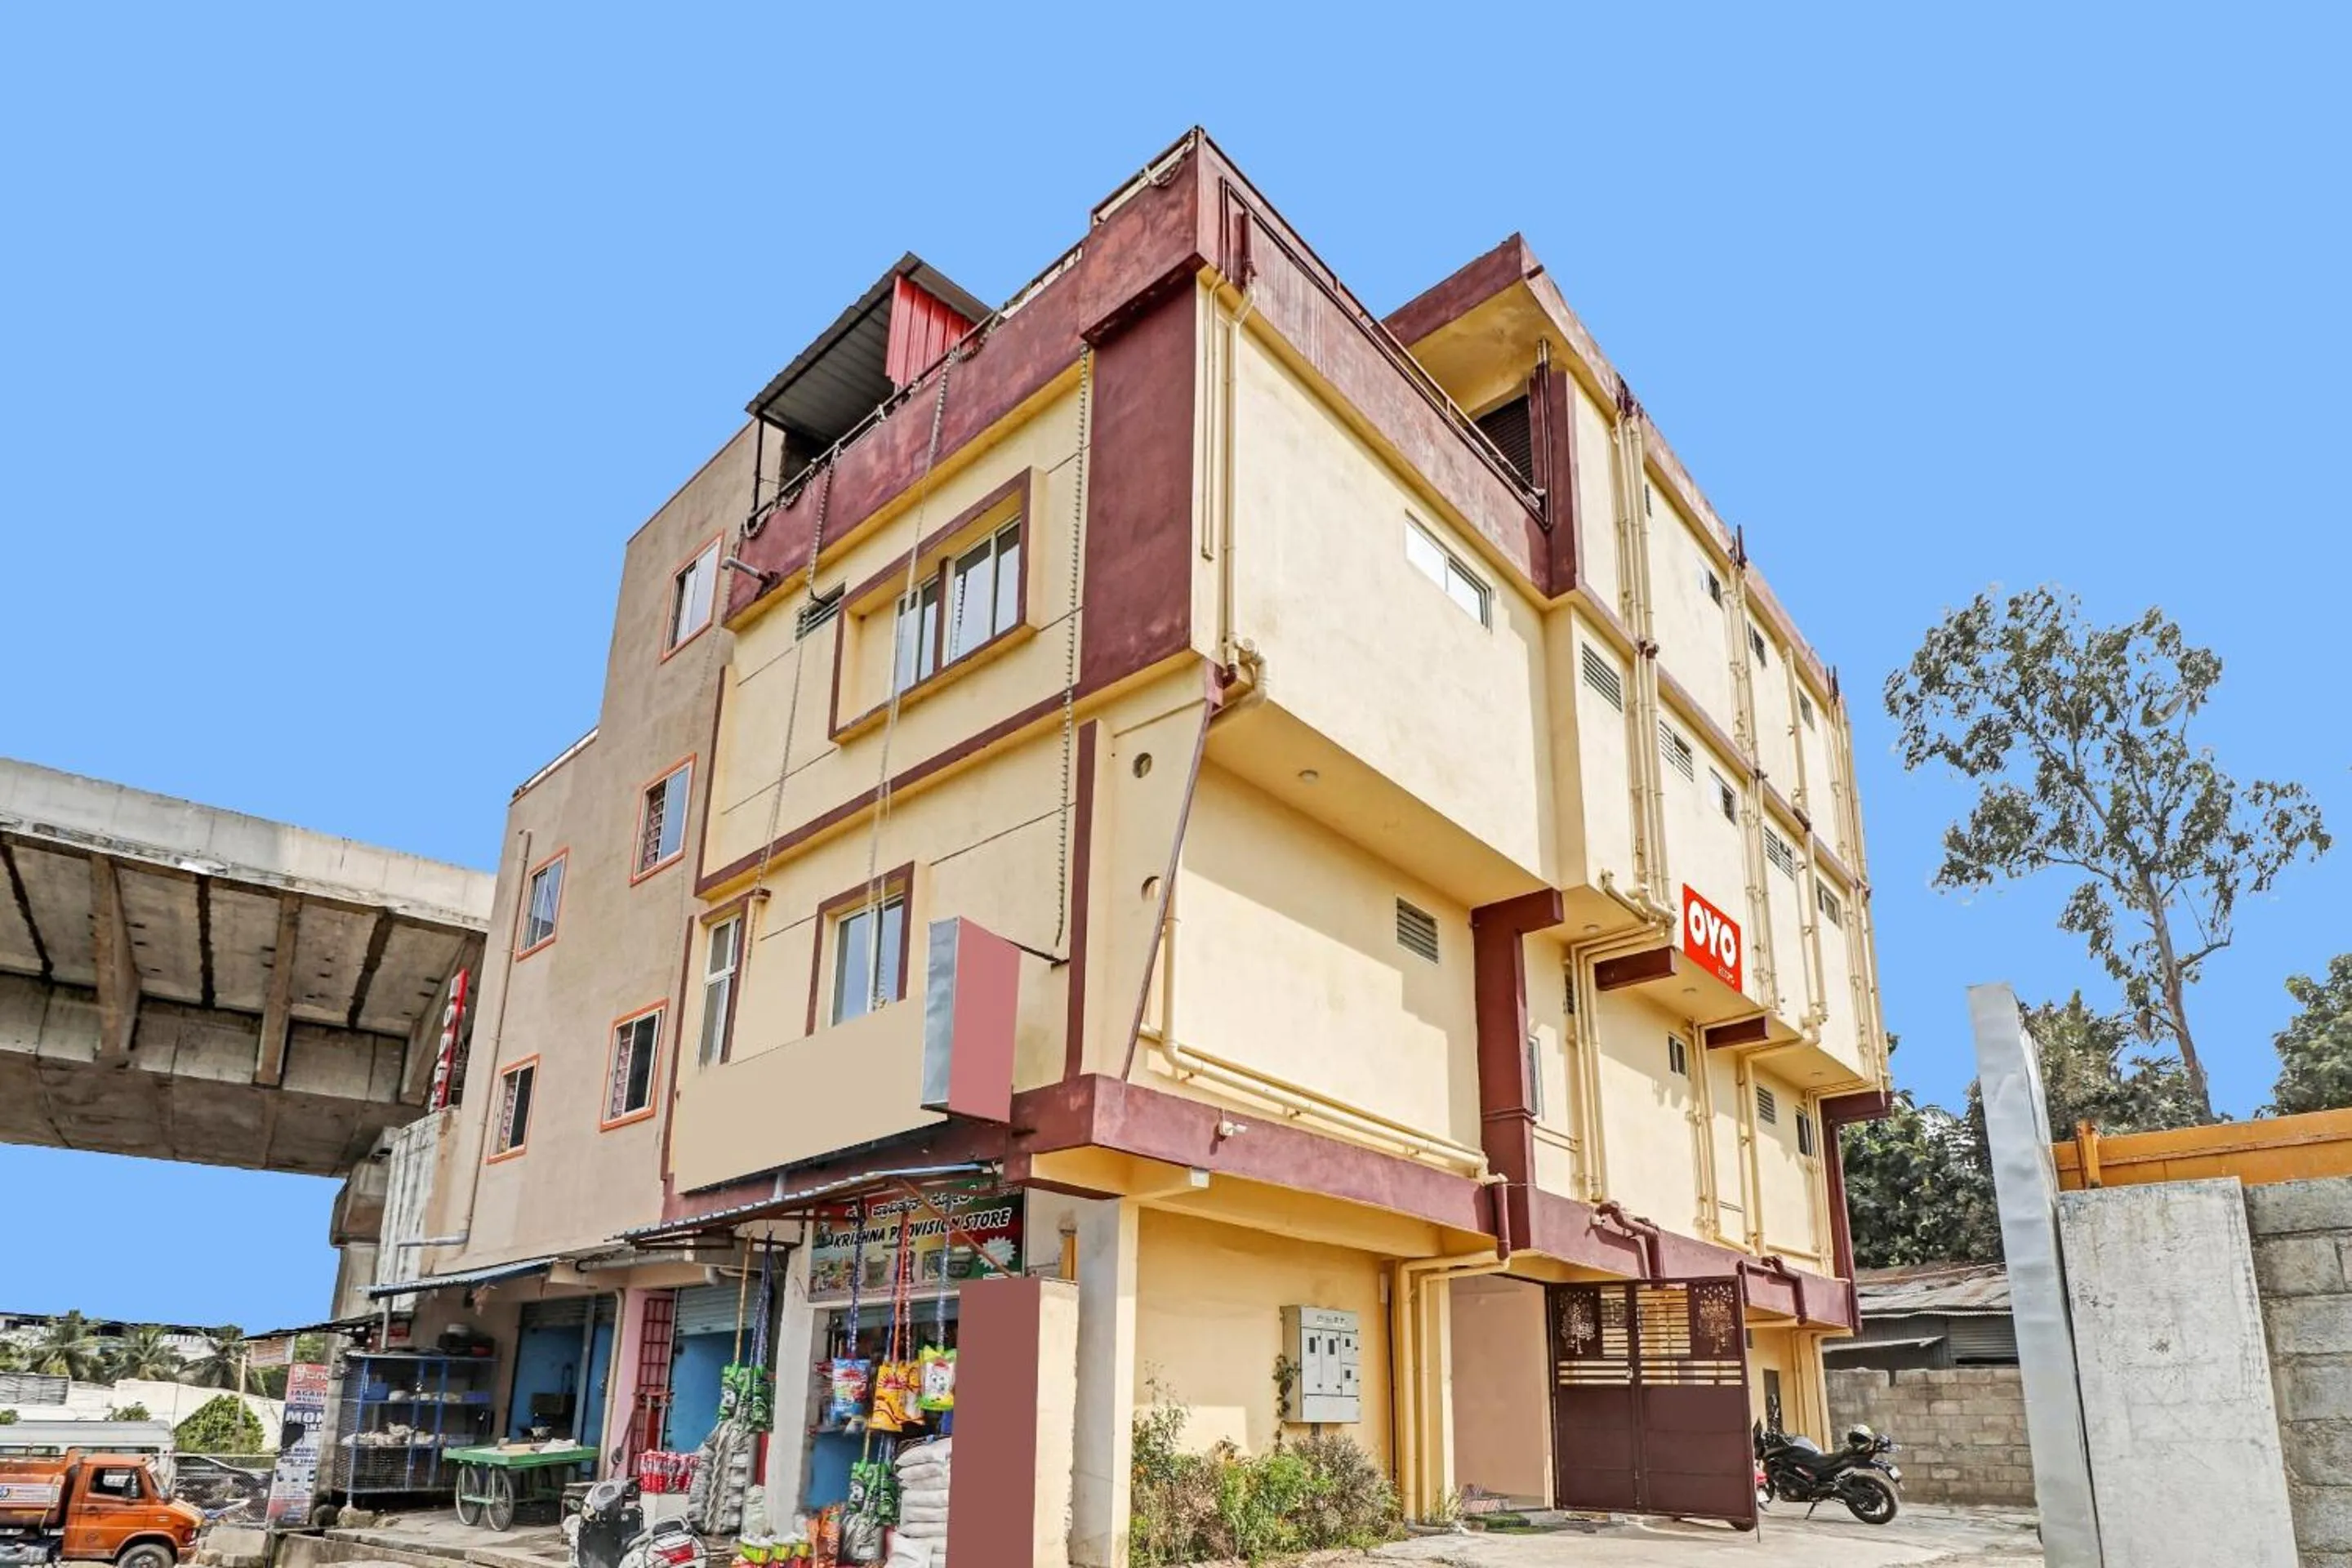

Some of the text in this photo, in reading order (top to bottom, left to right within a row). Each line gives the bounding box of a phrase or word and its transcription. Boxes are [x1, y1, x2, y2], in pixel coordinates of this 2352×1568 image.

[1688, 900, 1737, 969] OYO
[833, 1227, 886, 1248] KRISHNA
[962, 1207, 1012, 1231] STORE
